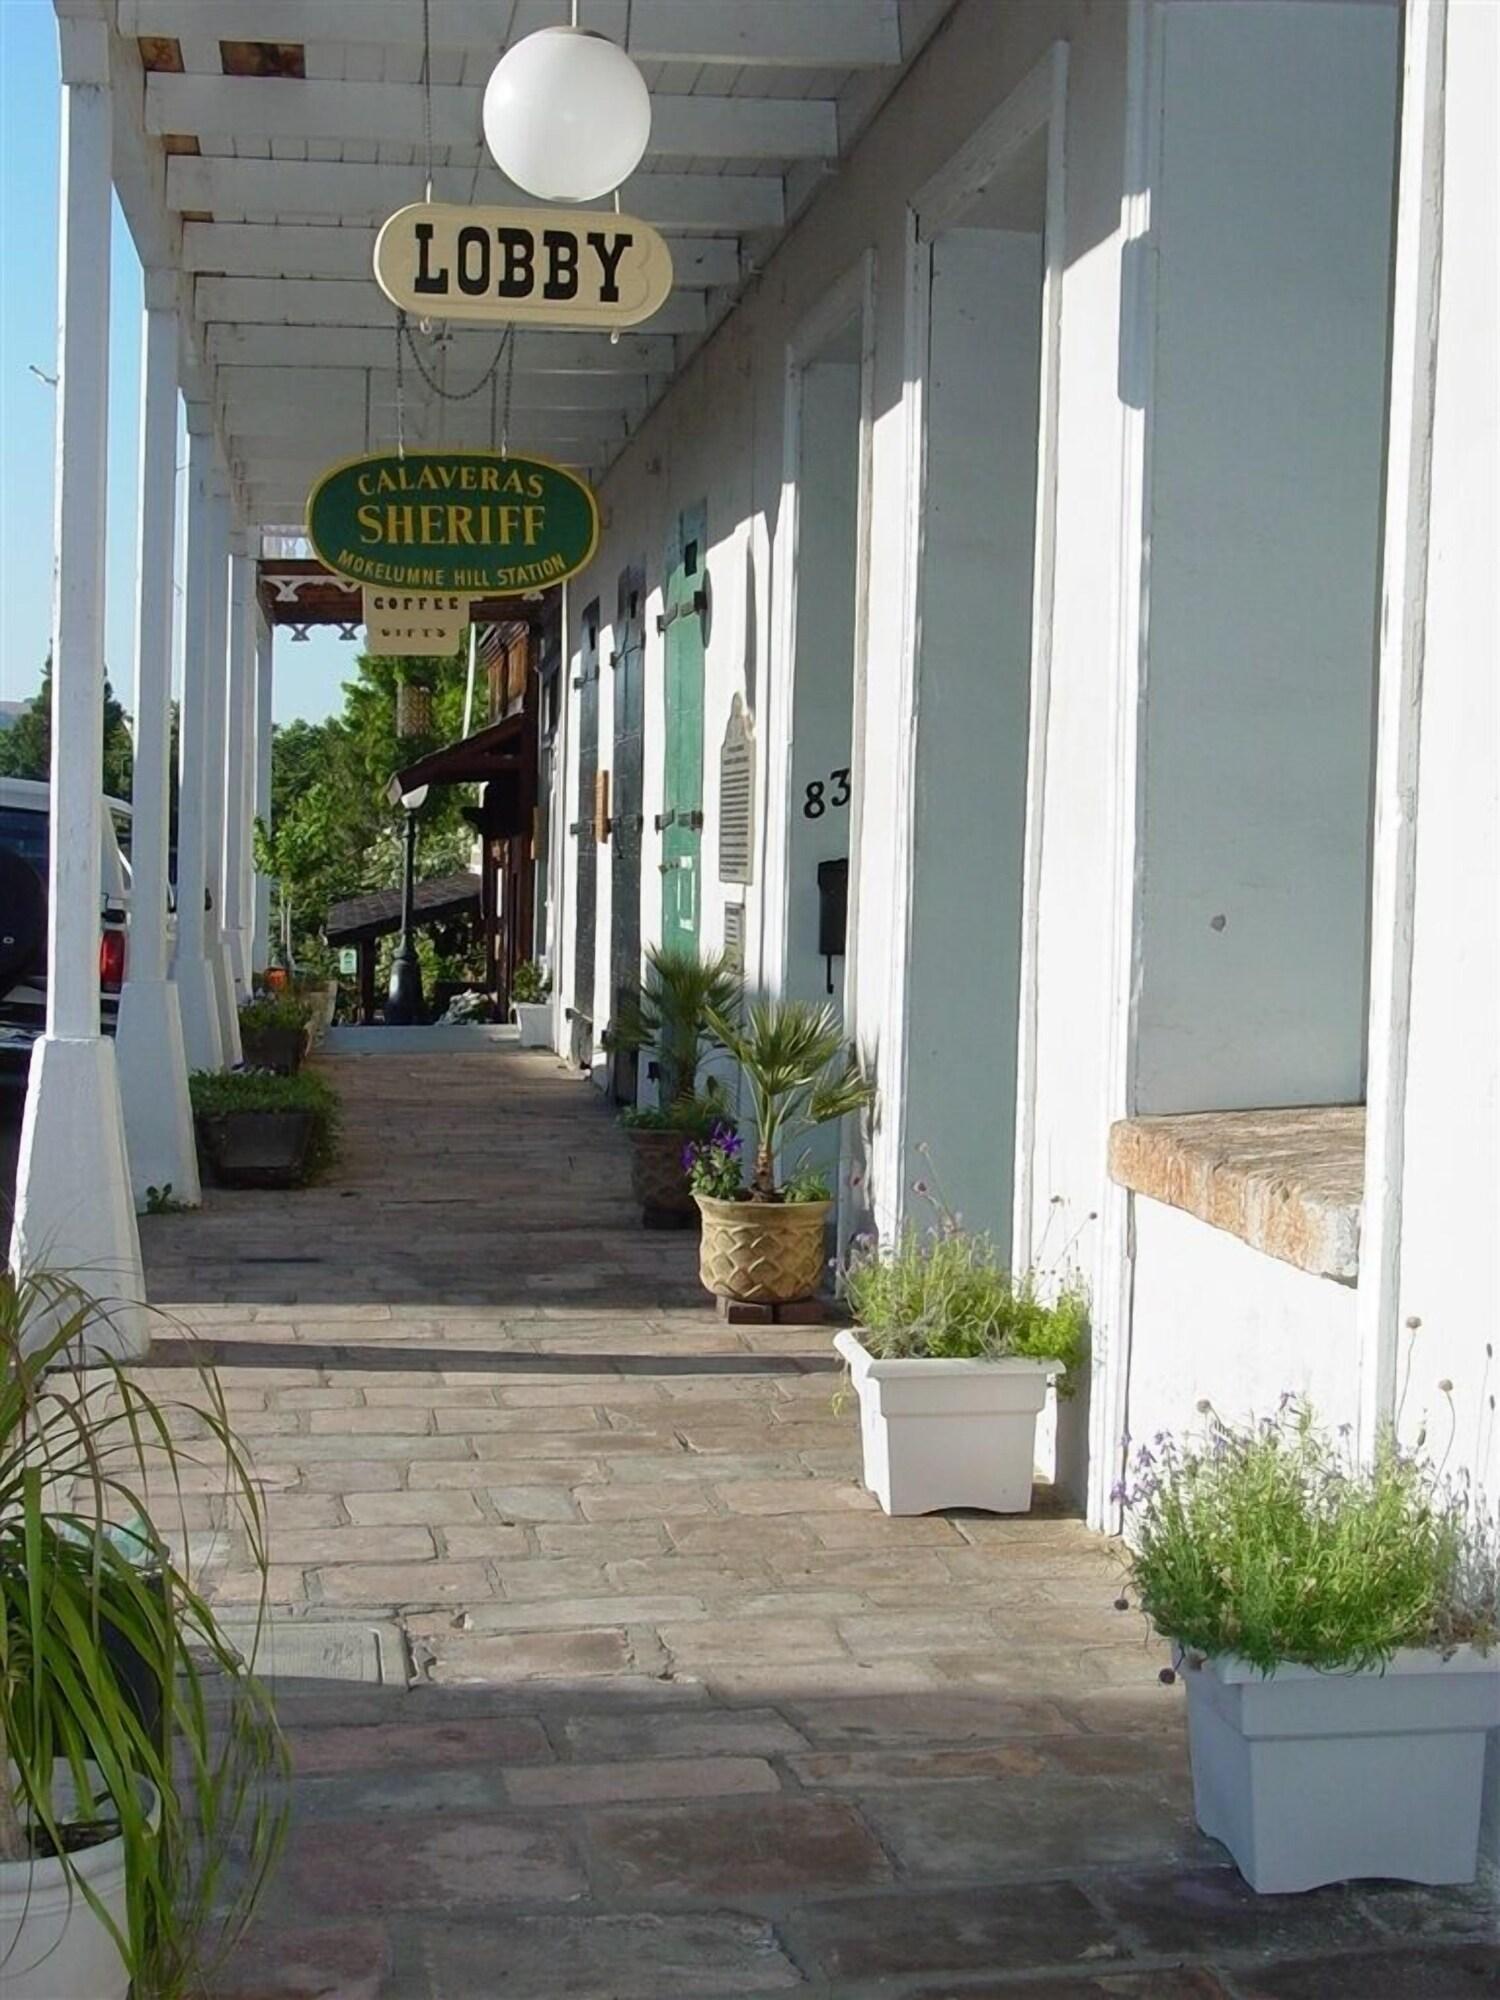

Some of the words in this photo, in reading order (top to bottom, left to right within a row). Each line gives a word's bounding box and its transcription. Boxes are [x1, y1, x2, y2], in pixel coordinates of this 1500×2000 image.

[414, 223, 633, 303] LOBBY
[357, 464, 544, 498] CALAVERAS
[356, 503, 546, 545] SHERIFF
[337, 549, 445, 586] MOKELUMNE
[453, 568, 490, 587] HILL
[497, 553, 567, 586] STATION
[373, 596, 459, 611] COFFEE
[803, 768, 851, 819] 83
